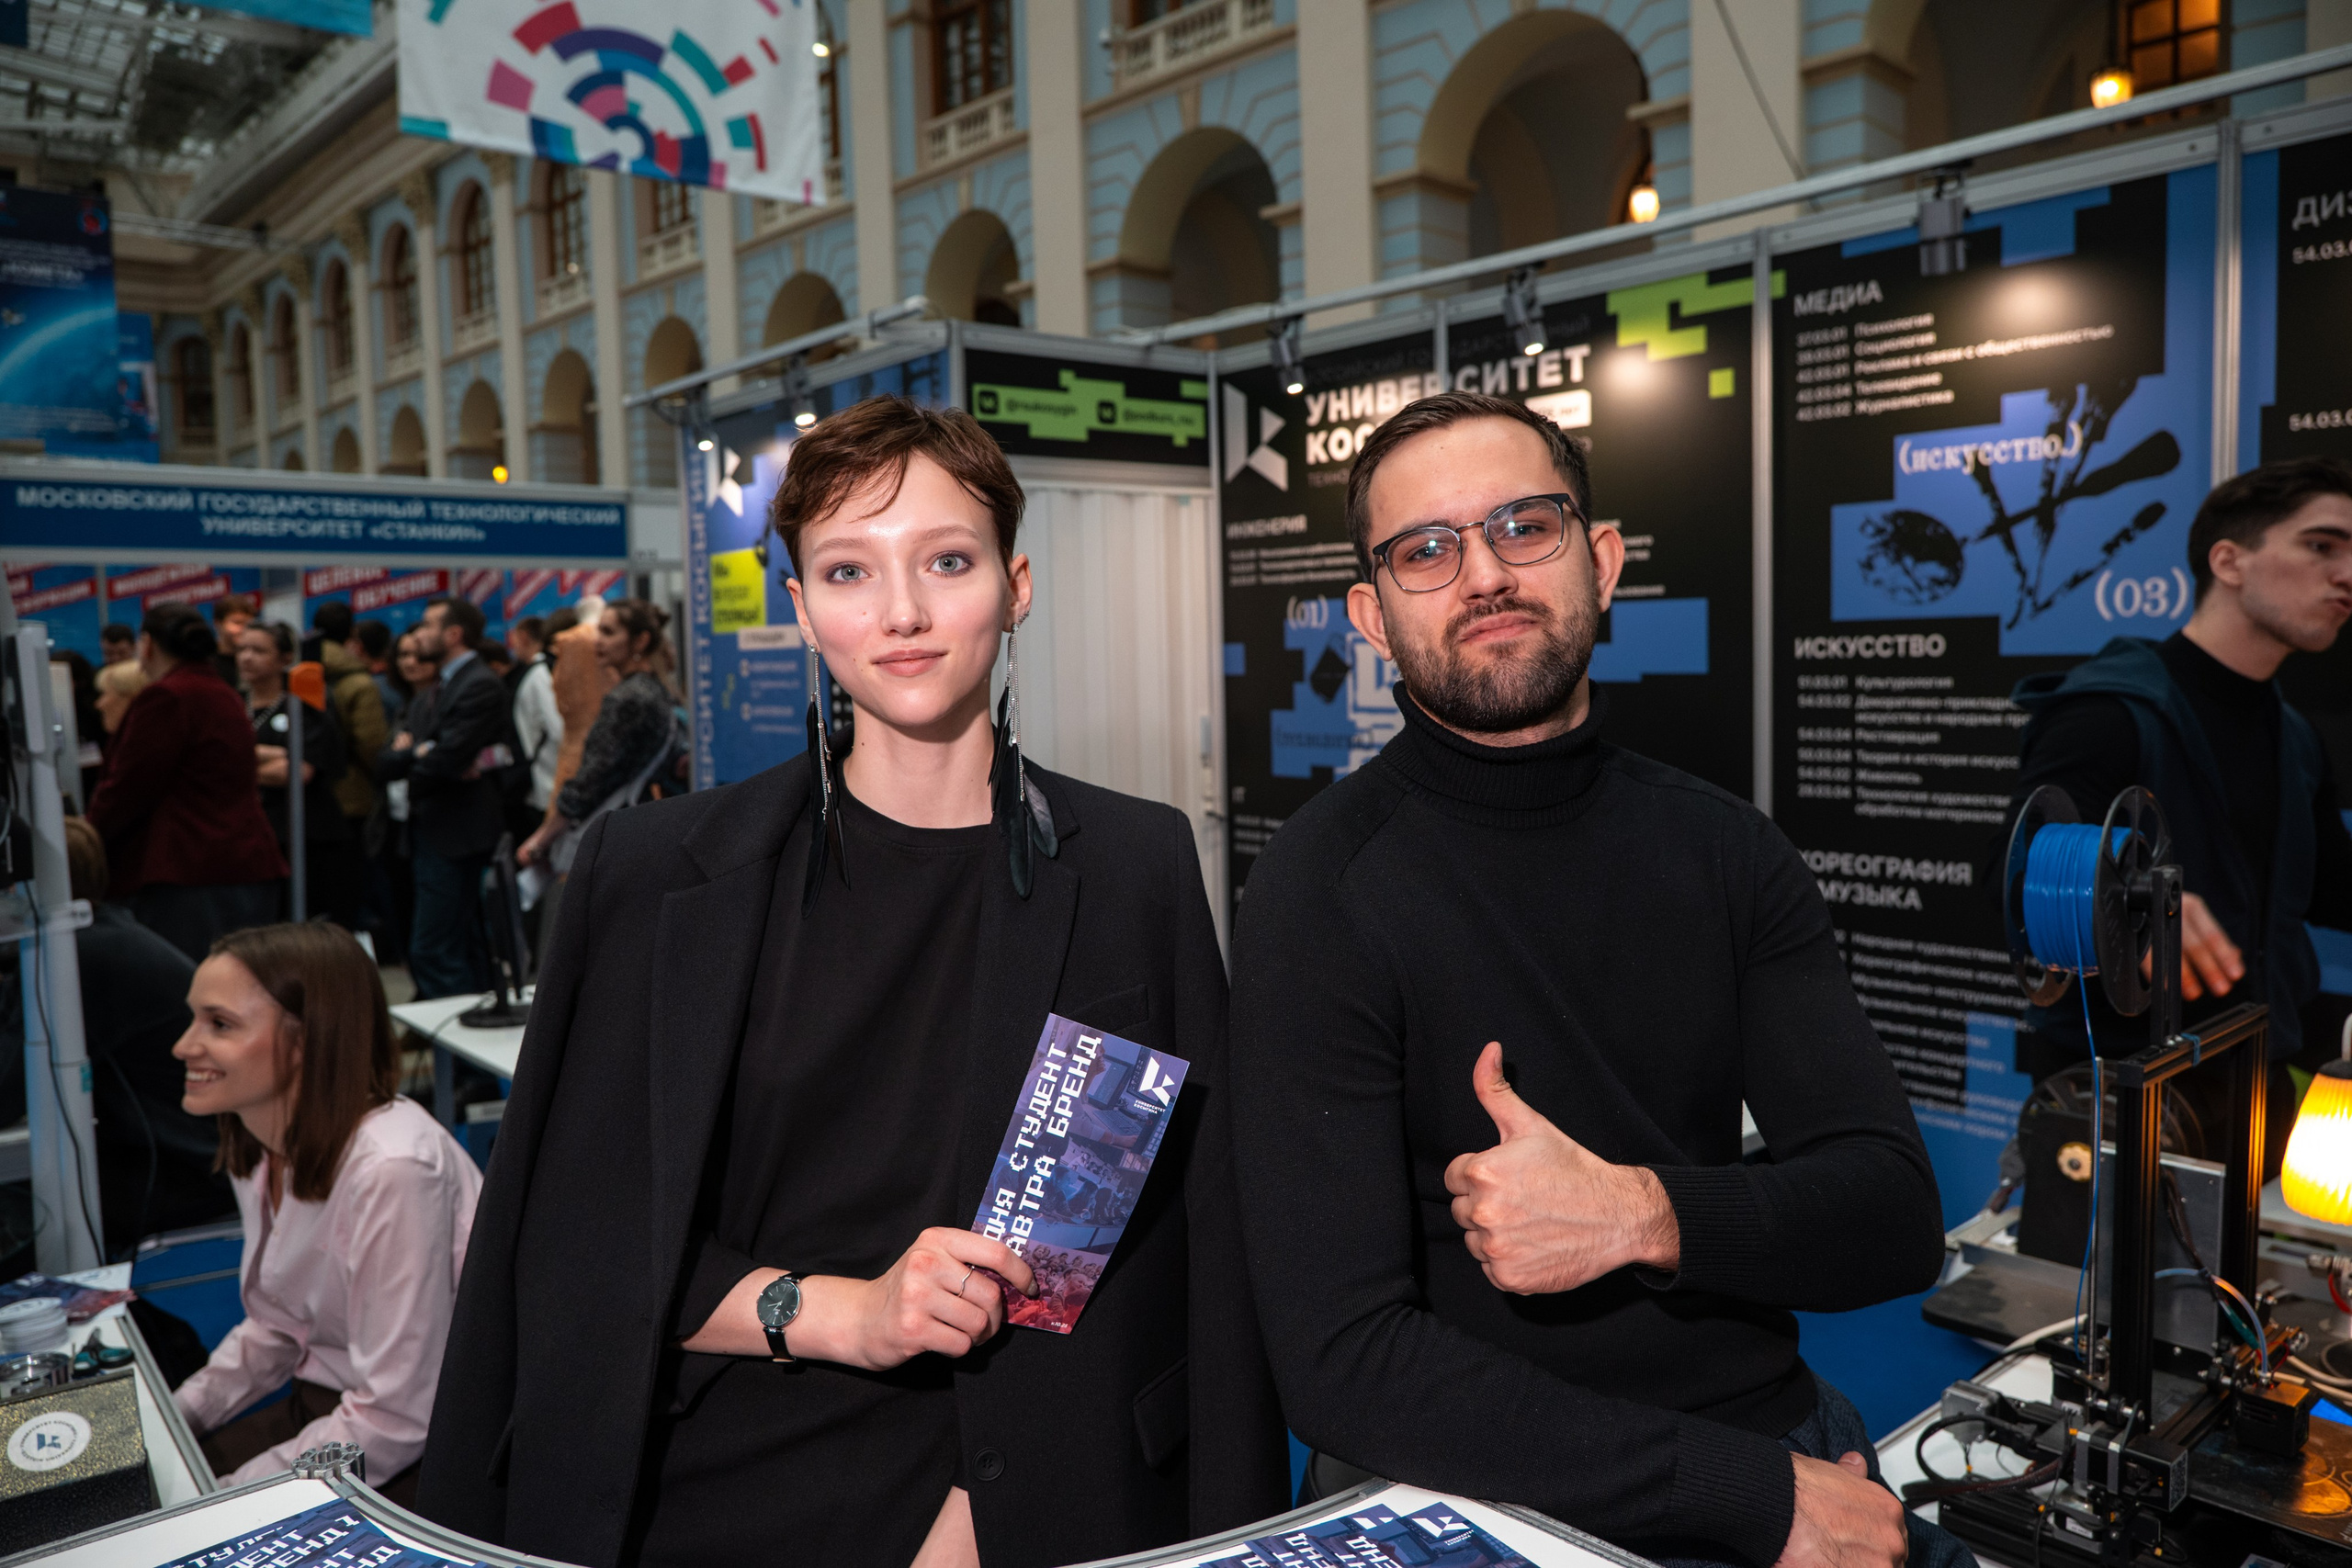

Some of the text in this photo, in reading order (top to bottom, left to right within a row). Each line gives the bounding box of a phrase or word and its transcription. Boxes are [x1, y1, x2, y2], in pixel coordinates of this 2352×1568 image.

[1793, 279, 1883, 317] МЕДИА
[1854, 332, 1937, 356] Социология
[1976, 323, 2114, 357] общественностью
[1854, 389, 1955, 416] Журналистика
[16, 486, 621, 526] МОСКОВСКИЙ ГОСУДАРСТВЕННЫЙ ТЕХНОЛОГИЧЕСКИЙ
[200, 515, 364, 540] УНИВЕРСИТЕТ
[1287, 594, 1329, 631] (01)
[2095, 567, 2188, 621] (03)
[1793, 633, 1948, 660] ИСКУССТВО
[695, 637, 716, 790] ЕРСИТЕТ
[1009, 1043, 1067, 1172] СТУДЕНТ
[1005, 1034, 1102, 1257] АВТРА БРЕНД
